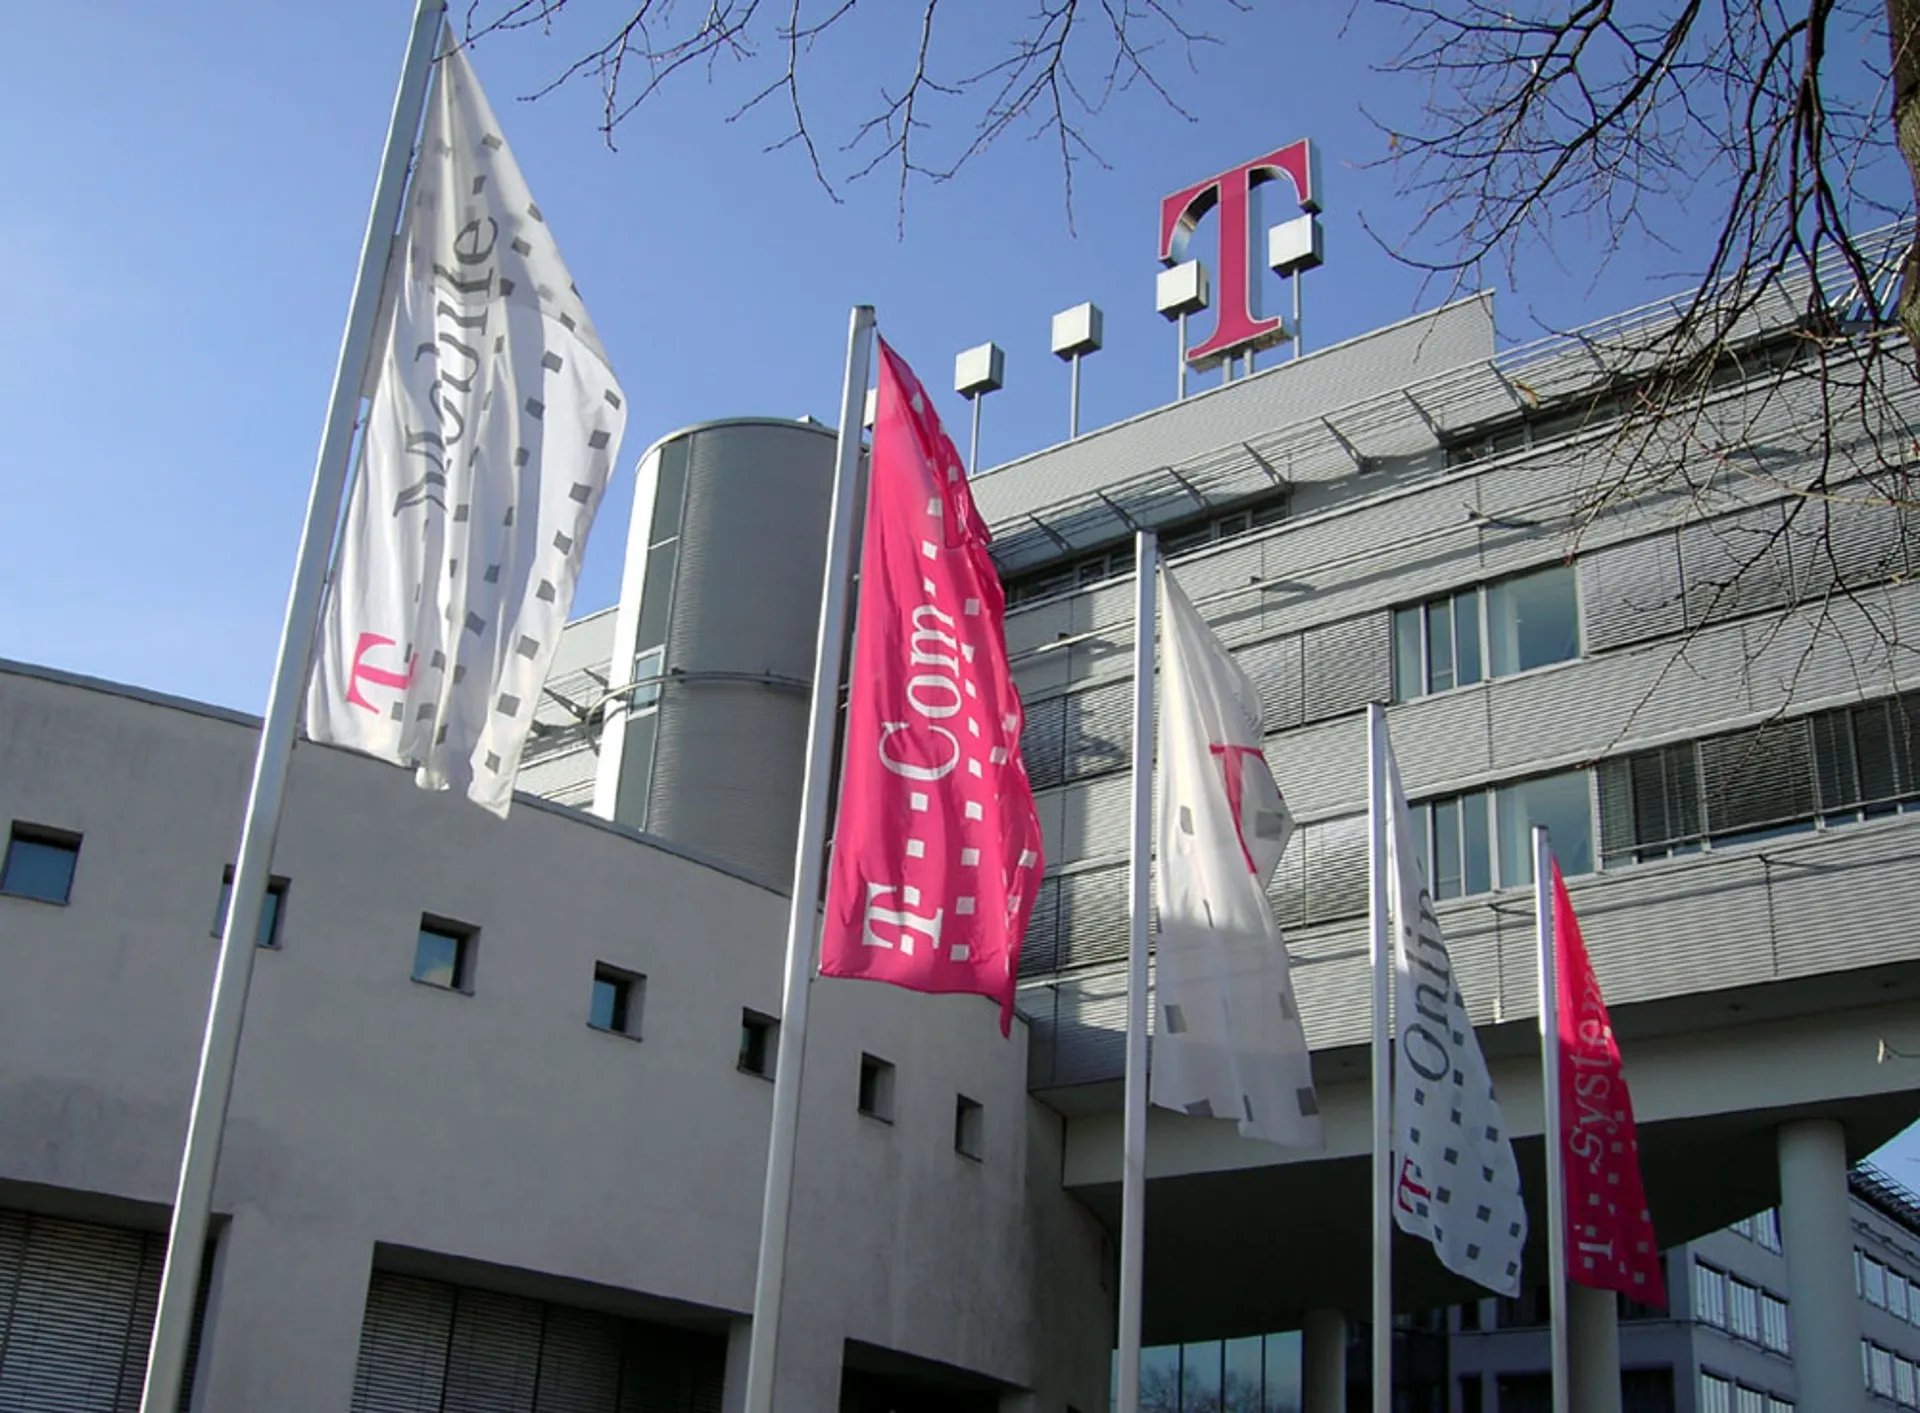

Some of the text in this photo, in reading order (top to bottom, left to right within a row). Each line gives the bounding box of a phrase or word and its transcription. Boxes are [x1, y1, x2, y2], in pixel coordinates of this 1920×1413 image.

[1159, 137, 1312, 362] T
[346, 632, 419, 714] T
[863, 602, 962, 955] T Com
[1396, 857, 1450, 1214] T Onlin
